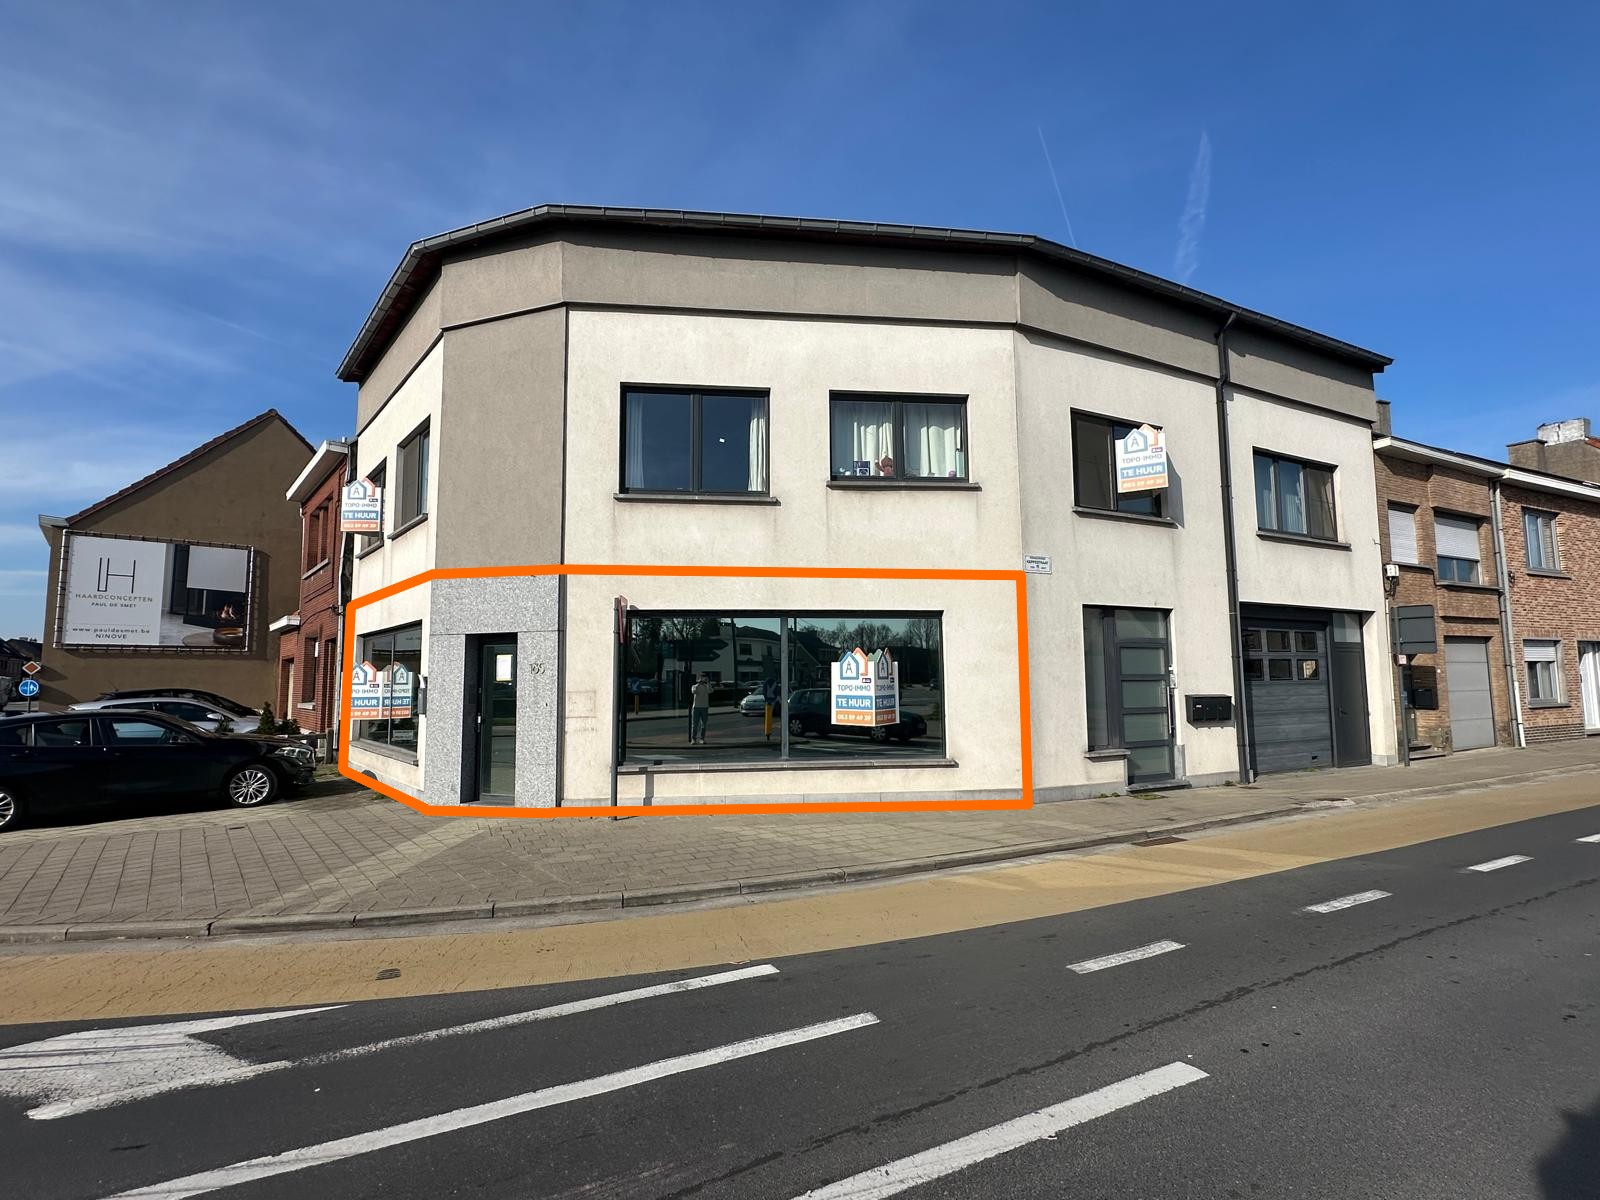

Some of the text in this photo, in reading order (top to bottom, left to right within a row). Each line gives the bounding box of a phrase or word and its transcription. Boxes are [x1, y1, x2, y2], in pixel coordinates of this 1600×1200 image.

[1122, 465, 1163, 477] TE HUUR
[75, 593, 153, 602] HAARDCONCEPTEN
[838, 698, 871, 707] TE HUUR
